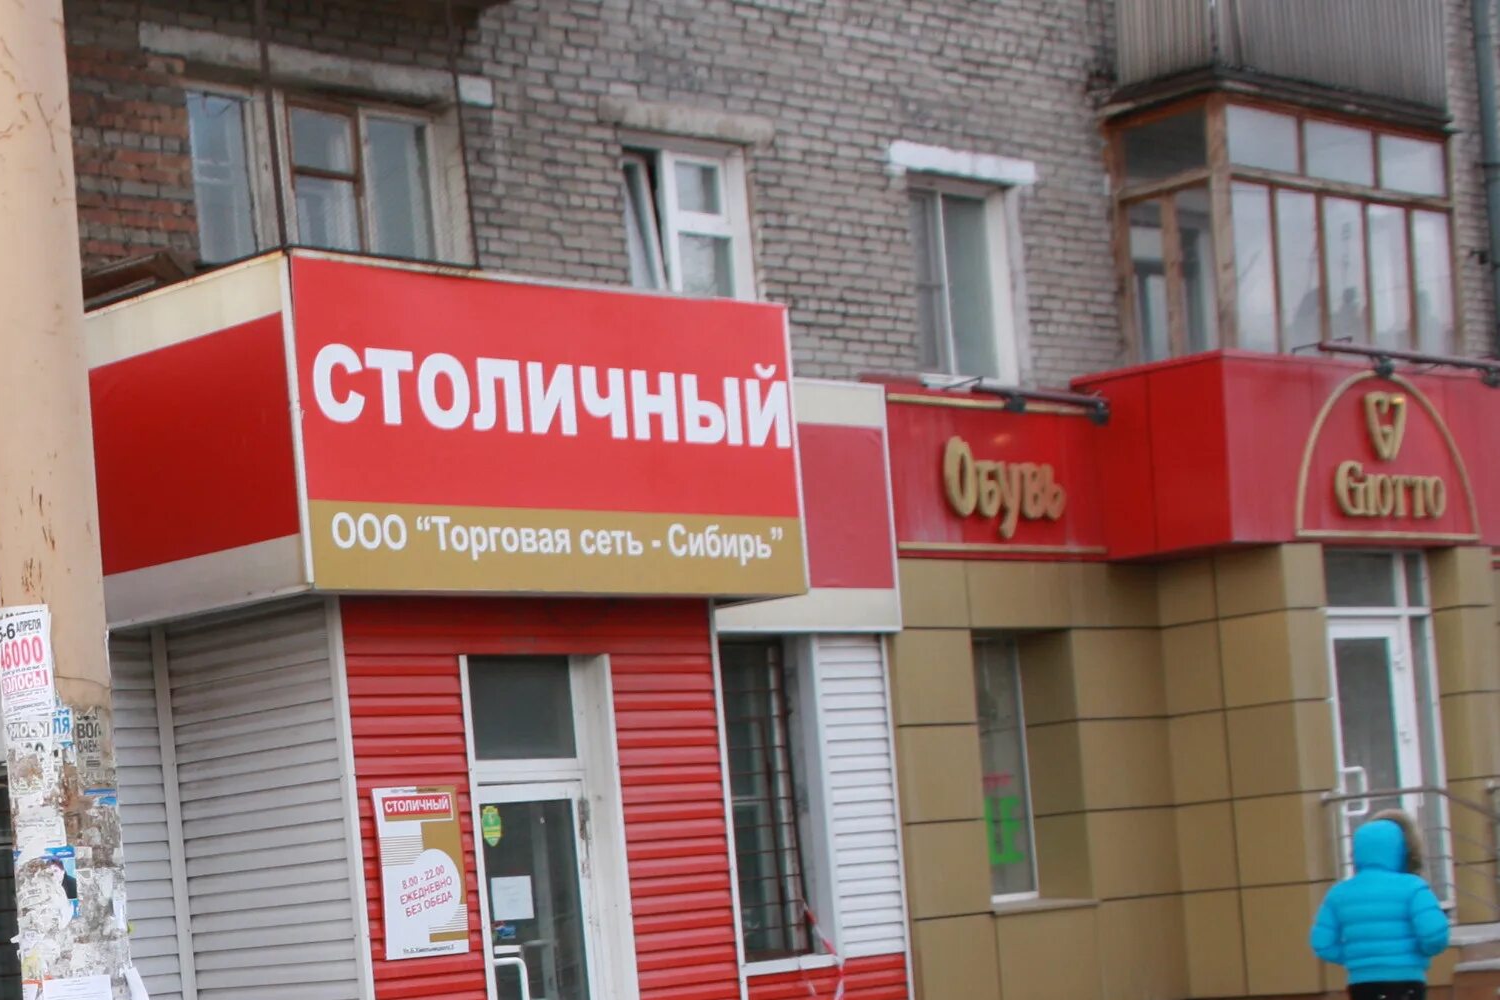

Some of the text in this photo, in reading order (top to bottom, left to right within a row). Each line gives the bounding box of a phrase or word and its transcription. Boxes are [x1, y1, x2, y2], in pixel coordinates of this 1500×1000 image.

[312, 343, 792, 449] СТОЛИЧНЫЙ
[331, 511, 408, 551] ООО
[579, 527, 644, 556] сеть
[16, 617, 42, 633] АПРЕЛЯ
[384, 796, 449, 813] СТОЛИЧНЫЙ
[400, 875, 453, 905] ЕЖЕДНЕВНО
[402, 875, 419, 890] 8.00
[424, 864, 445, 881] 22.00
[405, 890, 453, 917] БЕЗ ОБЕДА
